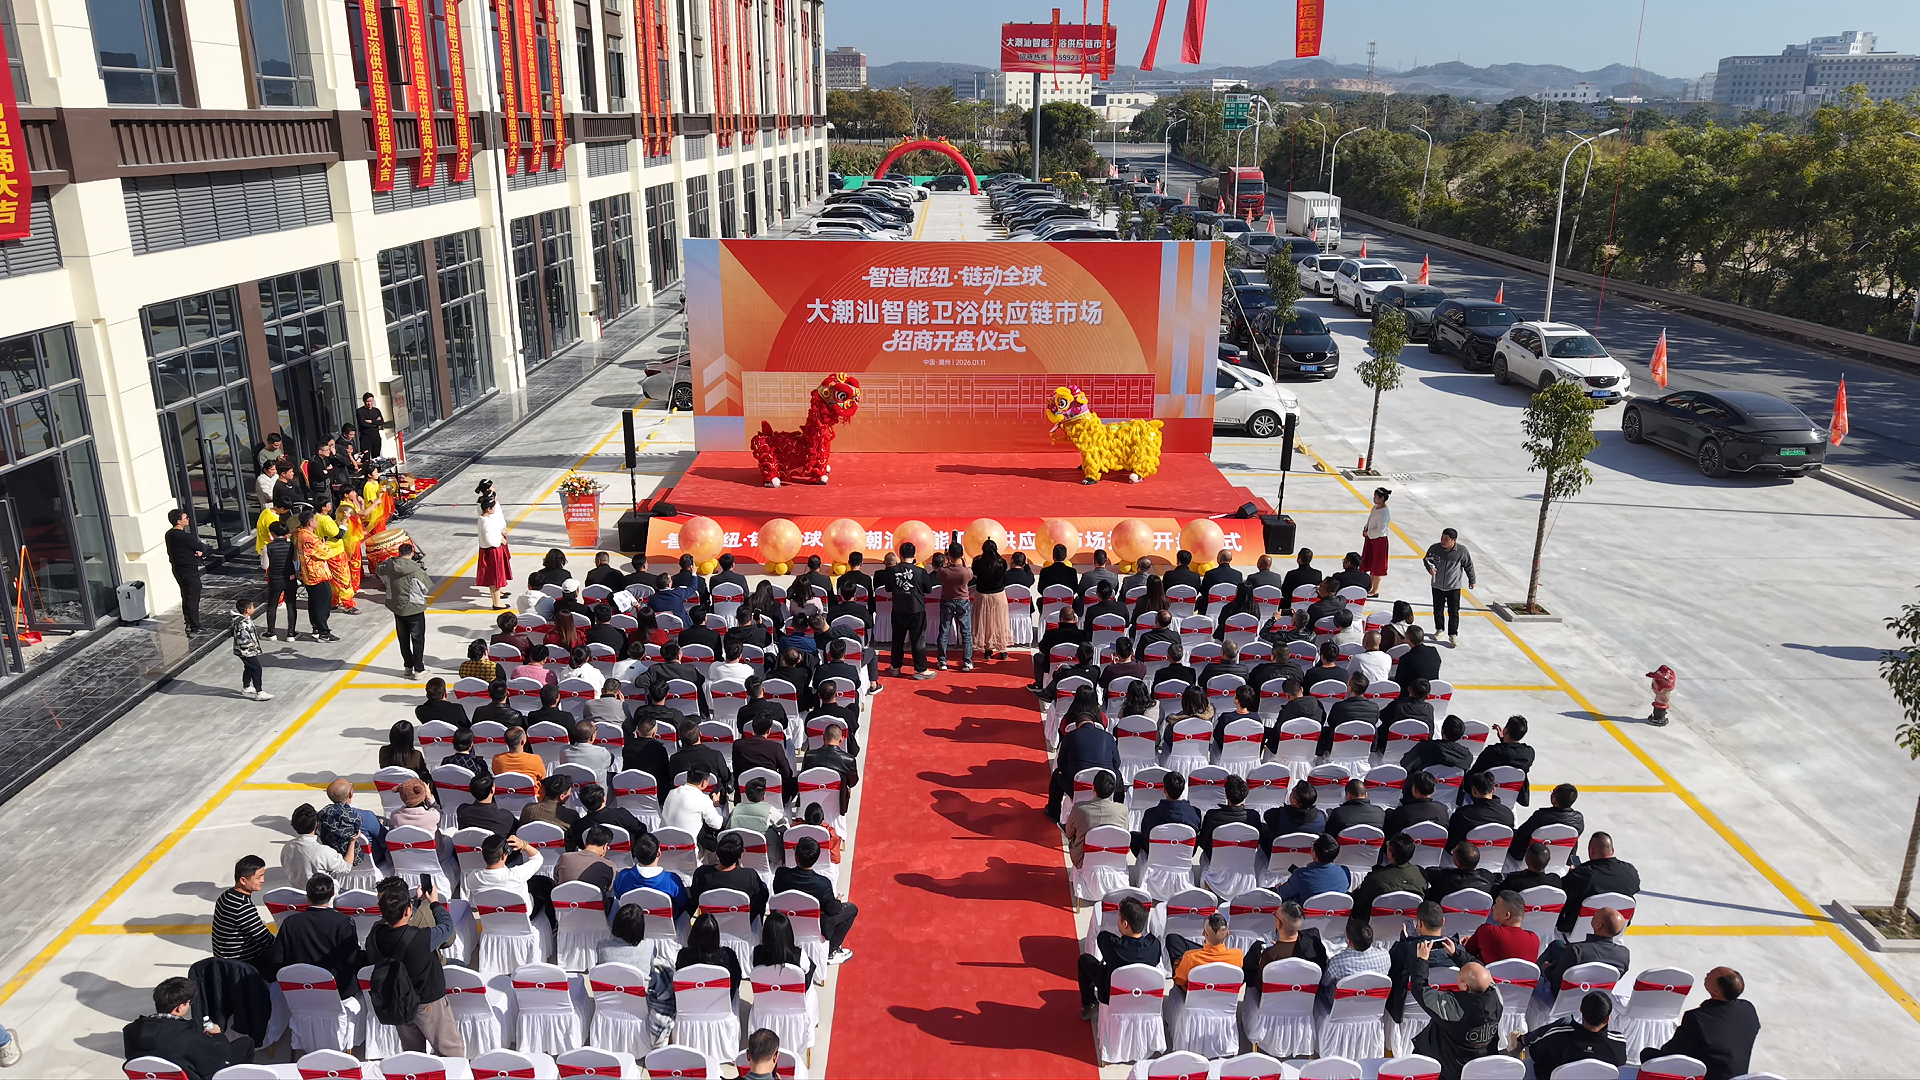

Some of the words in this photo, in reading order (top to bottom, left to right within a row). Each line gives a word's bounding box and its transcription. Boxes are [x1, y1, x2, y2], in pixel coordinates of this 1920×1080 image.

[861, 265, 1047, 296] 智造枢纽·链动全球
[806, 298, 1103, 325] 大潮汕智能卫浴供应链市场
[882, 329, 1027, 352] 招商开盘仪式
